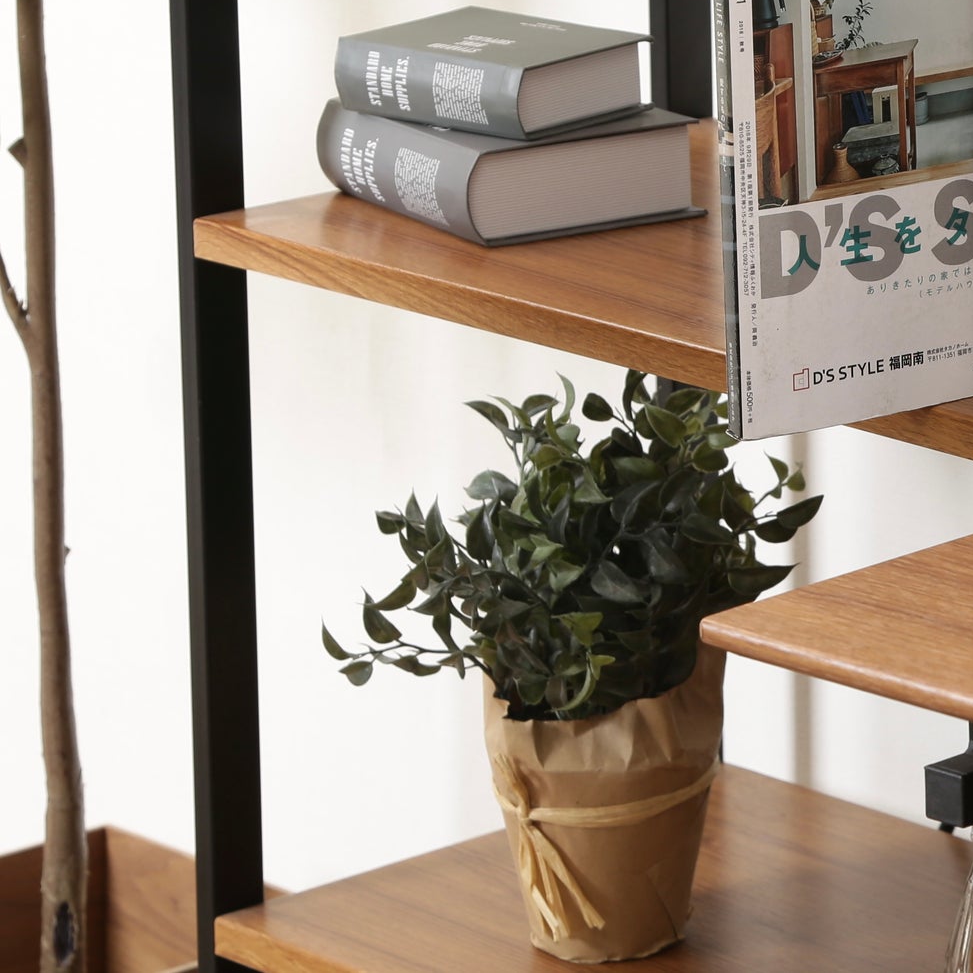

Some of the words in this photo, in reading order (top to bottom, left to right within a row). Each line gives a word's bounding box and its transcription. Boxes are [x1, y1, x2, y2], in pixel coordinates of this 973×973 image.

[366, 50, 382, 107] STANDARD
[381, 65, 394, 97] HOME
[395, 56, 411, 111] SUPPLIES.
[341, 128, 362, 194] STANDARD
[352, 147, 366, 185] HOME
[813, 368, 835, 385] D'S
[838, 359, 885, 380] STYLE
[889, 351, 924, 371] 福岡南
